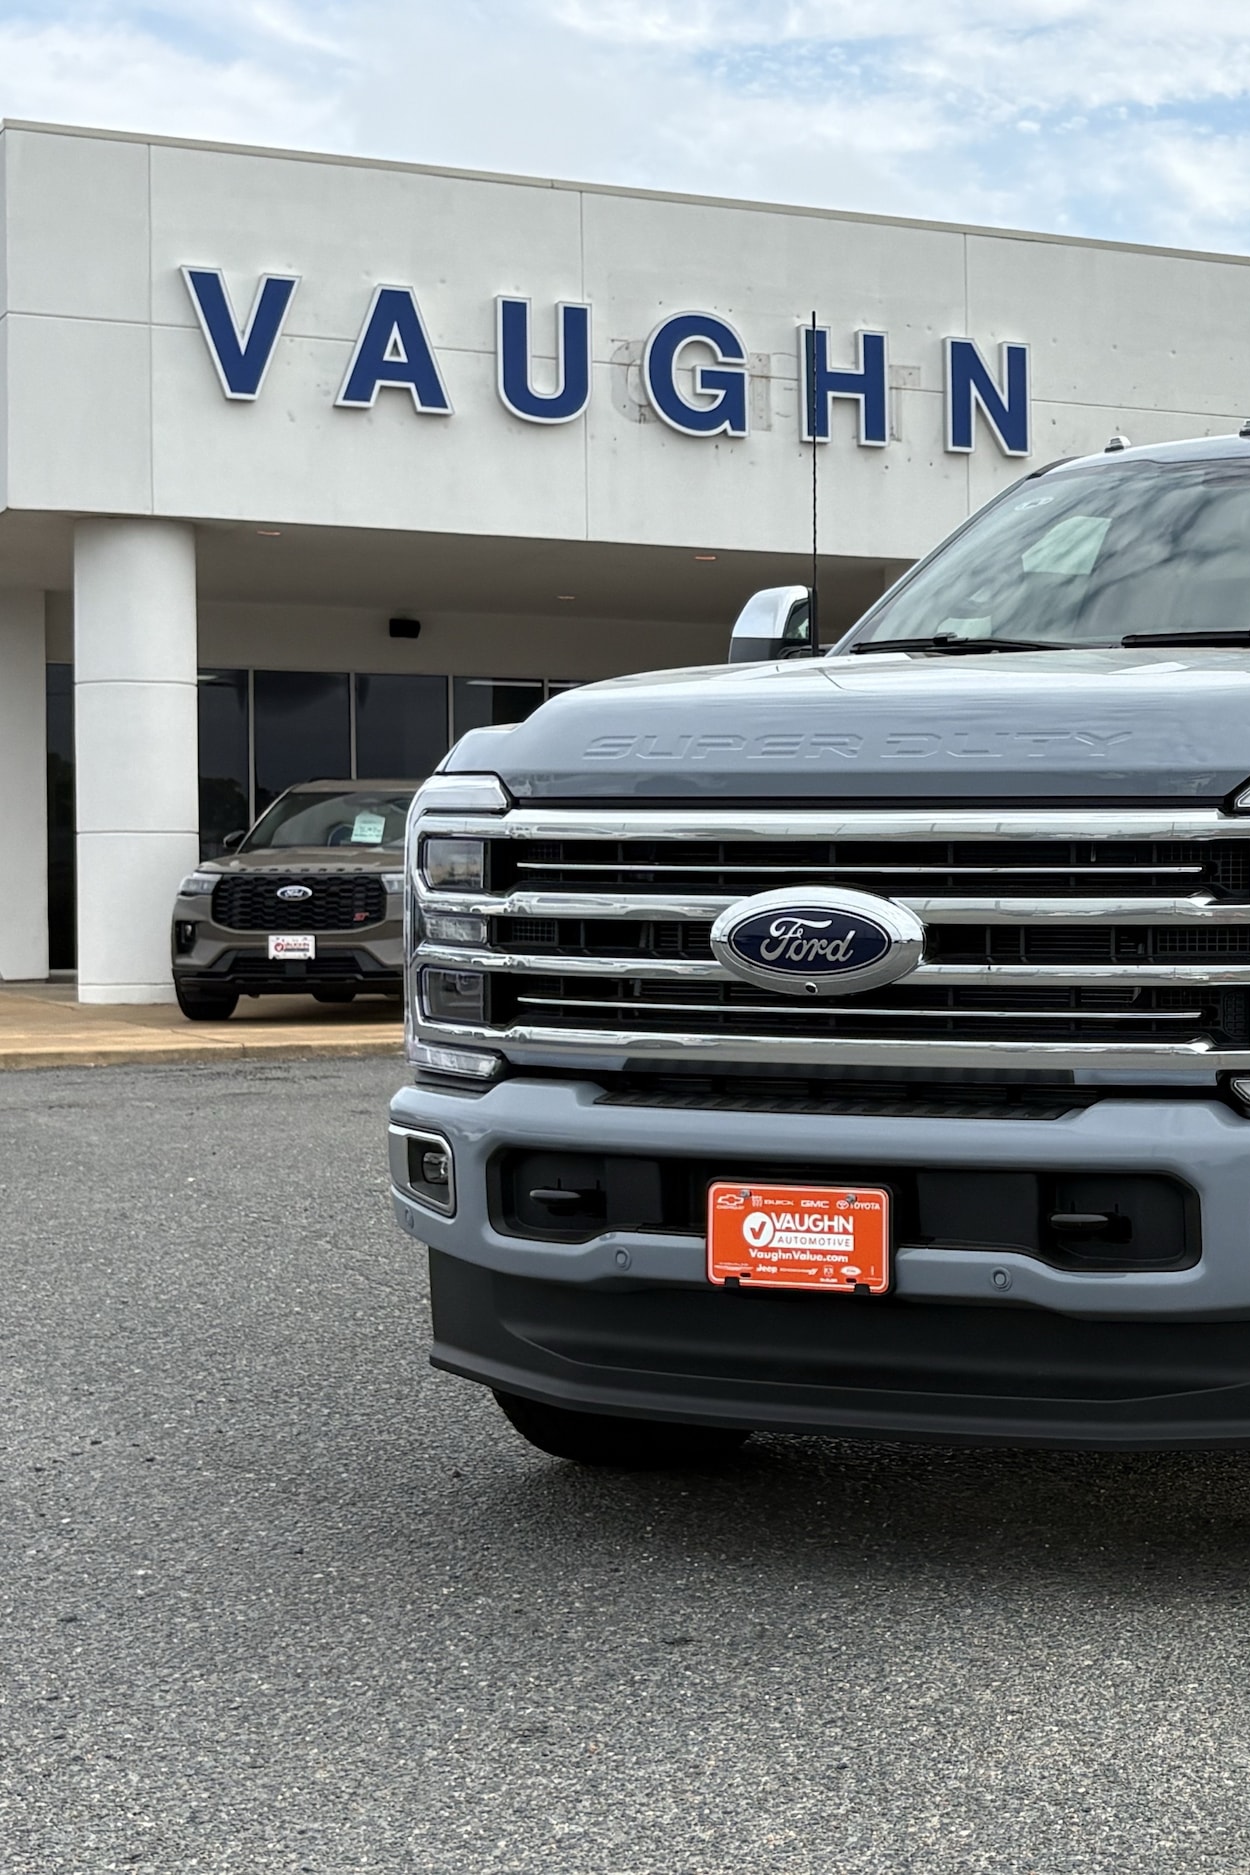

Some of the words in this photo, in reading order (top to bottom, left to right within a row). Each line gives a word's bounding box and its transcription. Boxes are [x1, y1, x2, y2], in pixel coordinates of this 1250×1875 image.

[180, 264, 1032, 457] VAUGHN
[582, 734, 866, 760] SUPER
[880, 731, 1134, 758] DUTY
[760, 917, 856, 962] Ford
[800, 1200, 830, 1208] GMC
[771, 1212, 854, 1232] VAUGHN
[777, 1236, 851, 1248] AUTOMOTIVE
[749, 1249, 849, 1263] VaughnValue.com
[756, 1264, 778, 1274] Jeep
